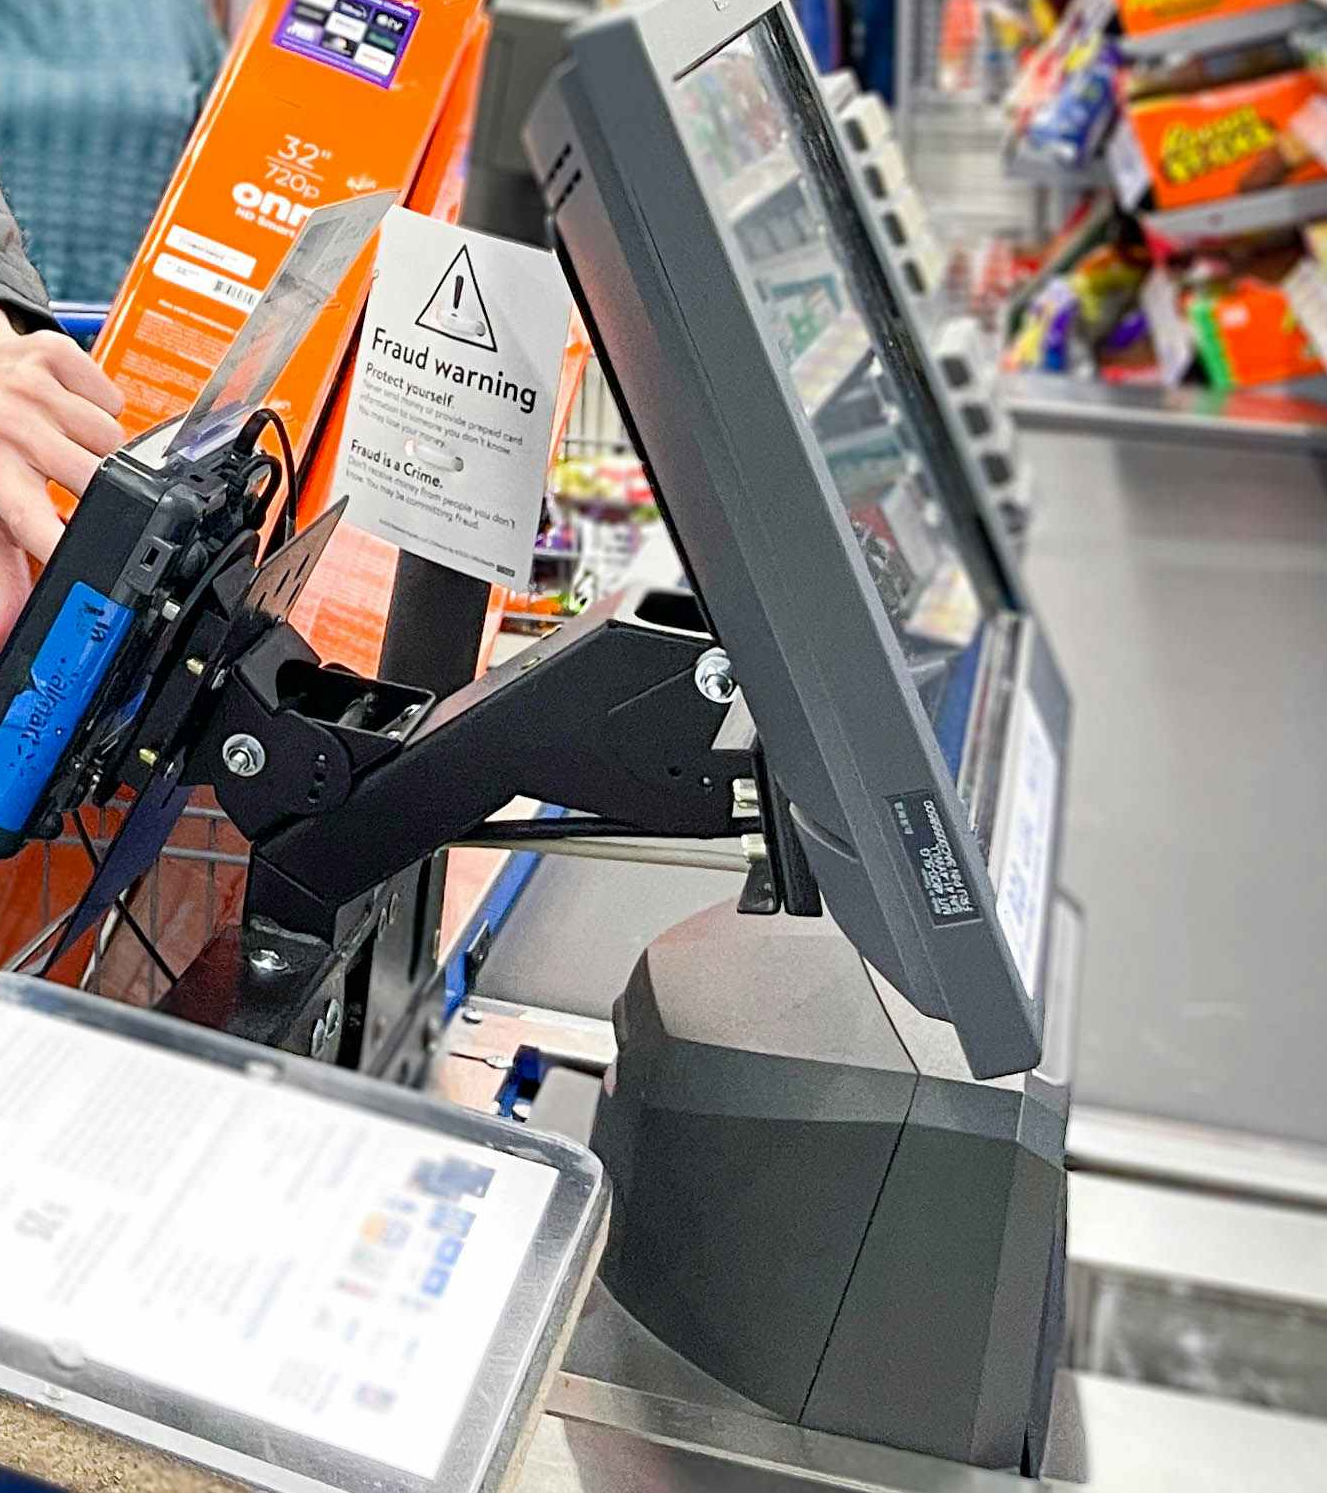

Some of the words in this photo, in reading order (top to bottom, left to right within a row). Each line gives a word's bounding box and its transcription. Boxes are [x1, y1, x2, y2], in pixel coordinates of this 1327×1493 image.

[278, 134, 333, 169] 32"
[265, 162, 320, 199] 720p
[366, 362, 404, 389] Protect
[372, 327, 429, 369] Fraud
[435, 358, 536, 413] warning
[401, 397, 424, 413] money
[435, 410, 466, 426] provide
[468, 422, 501, 438] prepaid
[503, 434, 522, 445] card
[444, 428, 460, 439] you
[351, 439, 381, 463] Fraud
[383, 452, 391, 468] is
[394, 461, 400, 471] a
[404, 462, 444, 488] Crime.
[420, 487, 442, 500] from
[442, 497, 472, 513] people
[474, 509, 490, 520] you
[20, 668, 77, 746] almart
